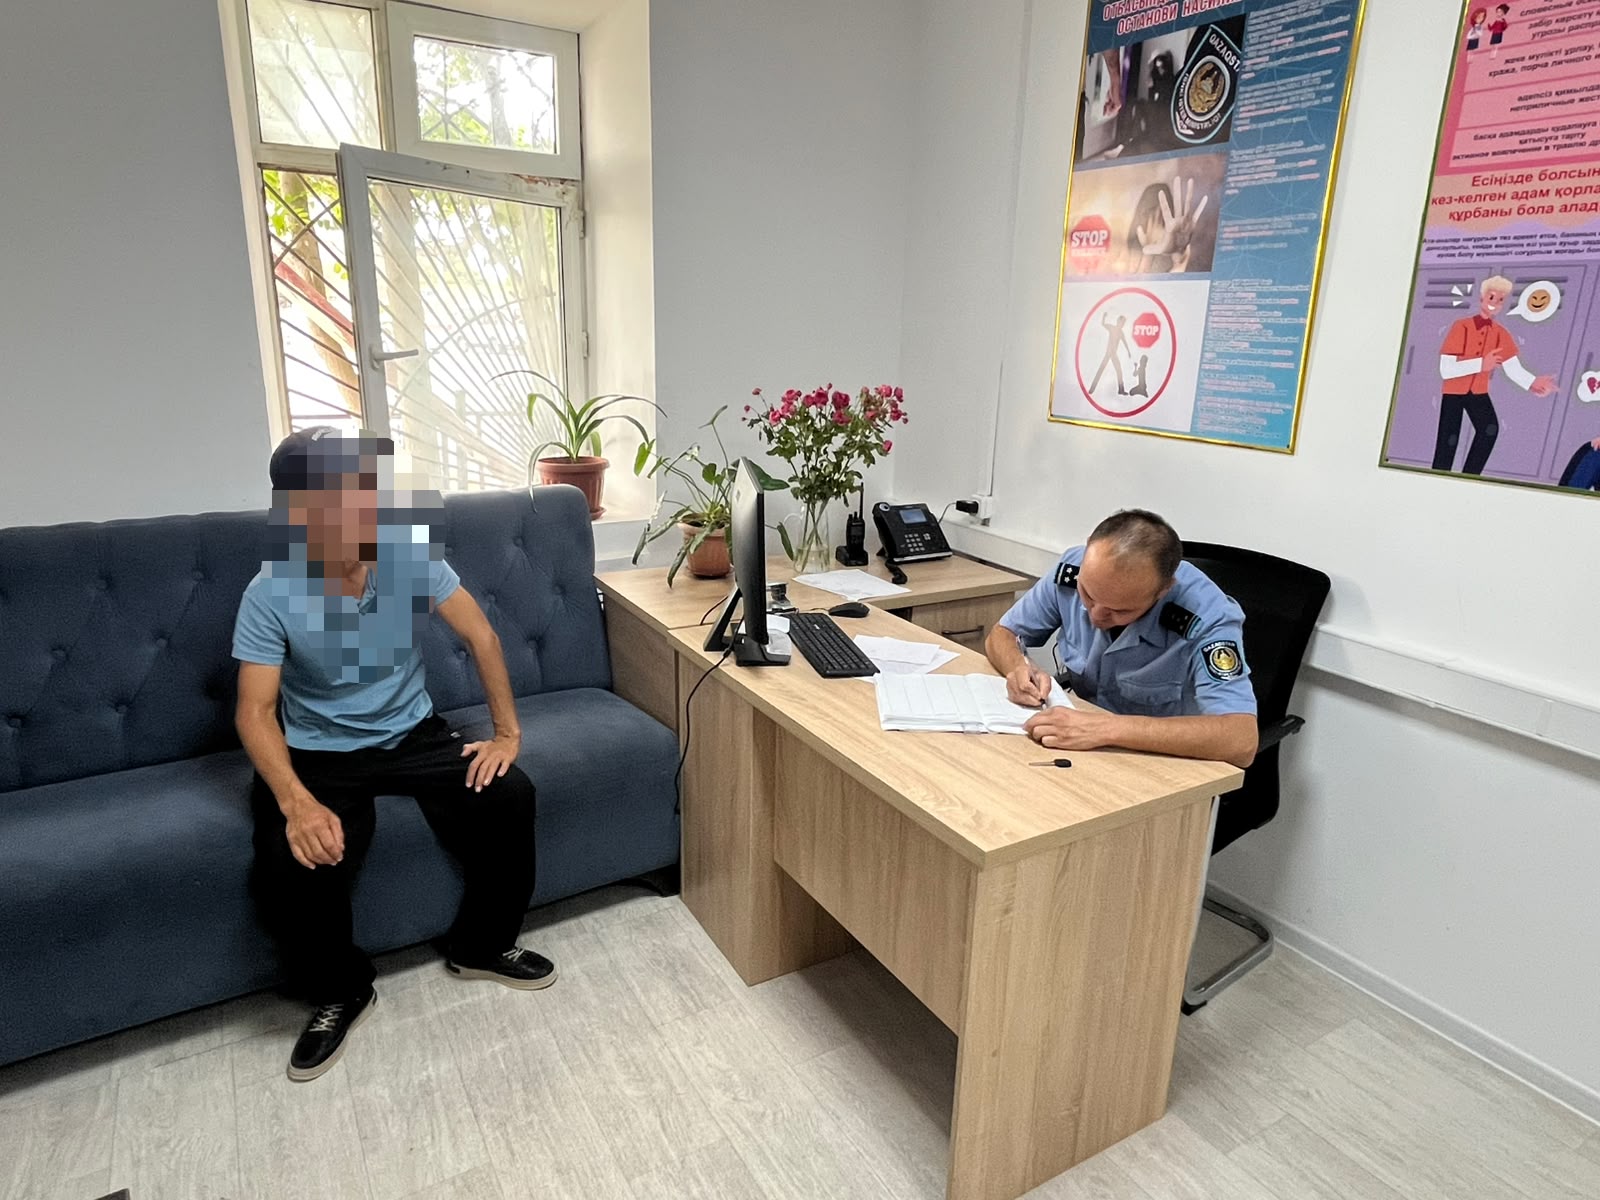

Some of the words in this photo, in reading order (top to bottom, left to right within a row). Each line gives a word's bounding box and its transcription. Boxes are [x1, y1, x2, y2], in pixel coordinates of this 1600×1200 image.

[1116, 2, 1179, 35] ОСТАНОВИ
[1471, 172, 1534, 187] Есіңізде
[1431, 191, 1507, 206] кез-келген
[1511, 187, 1550, 201] адам
[1449, 206, 1512, 221] құрбаны
[1516, 203, 1554, 215] бола
[1558, 201, 1600, 213] алад
[1071, 230, 1108, 248] STOP
[1133, 324, 1159, 337] STOP
